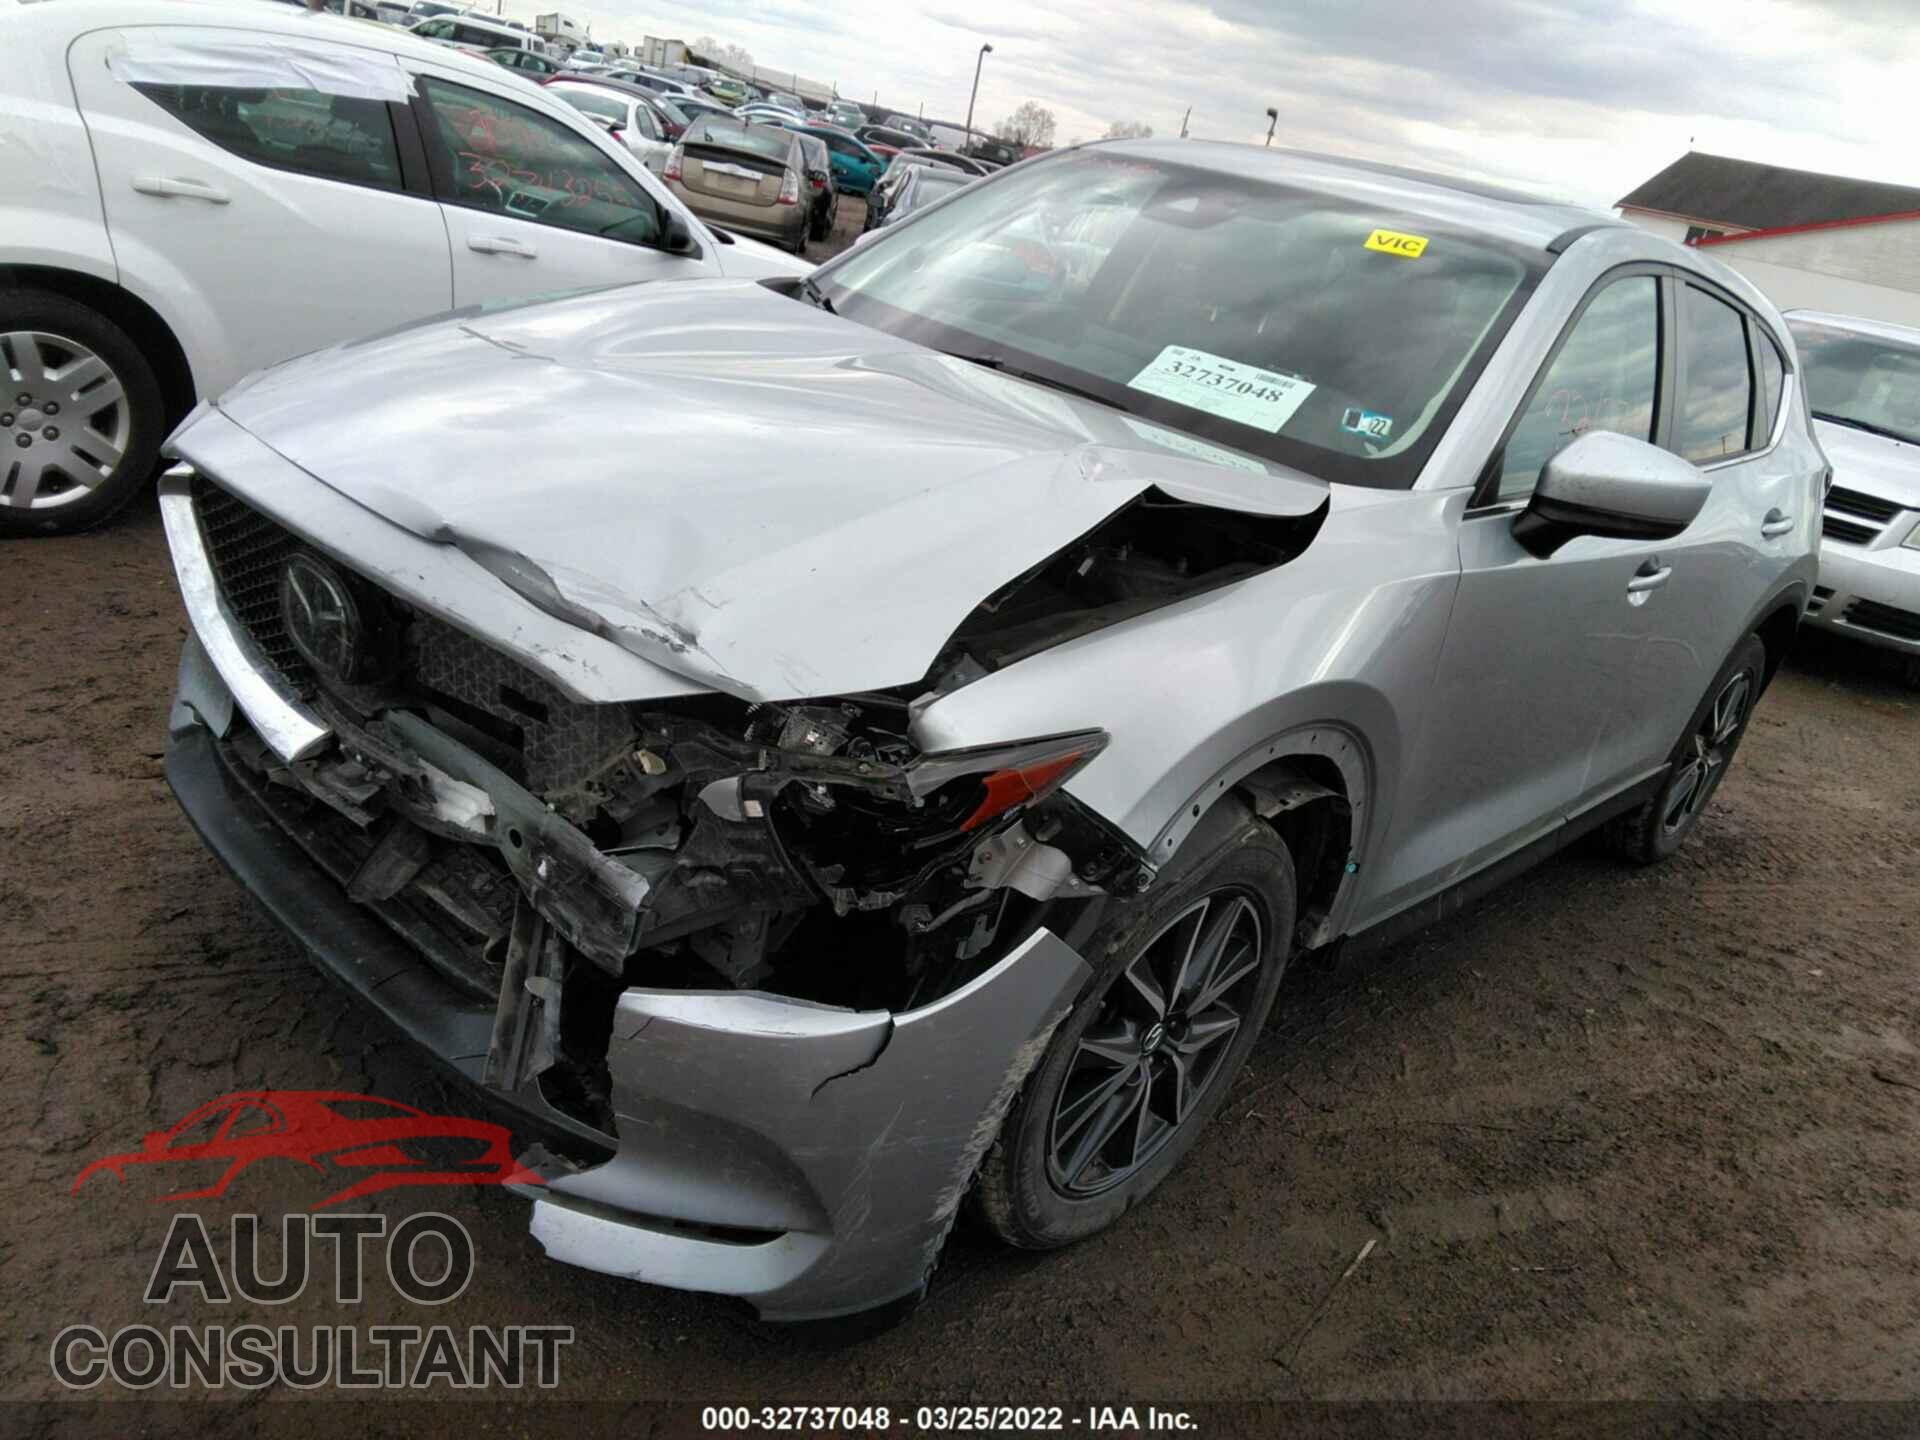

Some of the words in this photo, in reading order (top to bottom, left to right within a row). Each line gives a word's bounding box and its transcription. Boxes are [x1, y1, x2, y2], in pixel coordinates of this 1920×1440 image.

[1377, 235, 1421, 252] VIC
[1164, 360, 1284, 402] 32737048
[1370, 417, 1387, 436] 22
